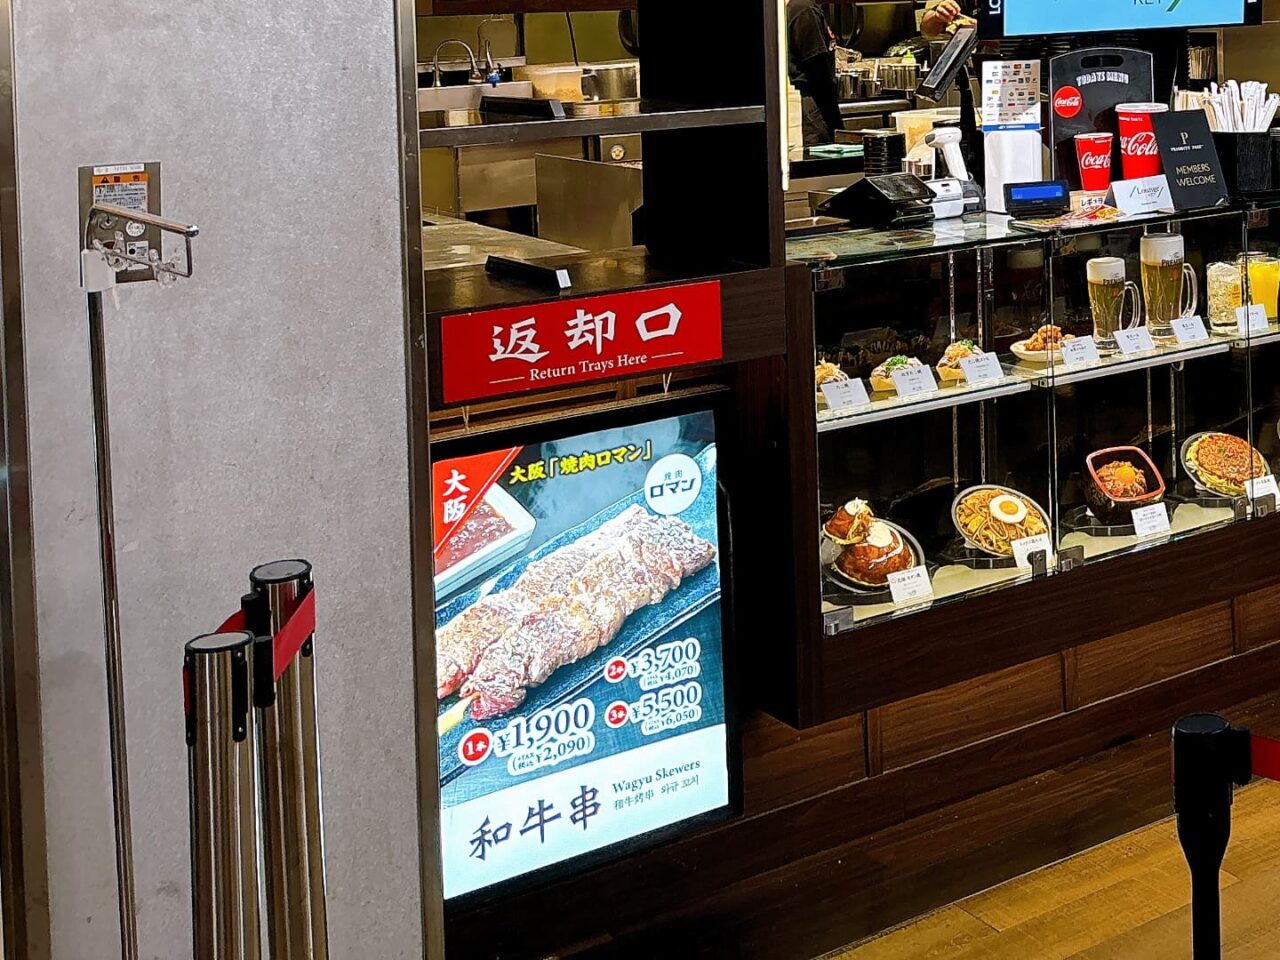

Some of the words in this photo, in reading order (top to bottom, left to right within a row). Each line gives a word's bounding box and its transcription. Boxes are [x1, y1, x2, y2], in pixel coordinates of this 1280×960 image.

[1175, 163, 1211, 175] MEMBERS
[1176, 174, 1217, 187] WELCOME
[488, 302, 683, 364] 返却口
[529, 364, 576, 381] Return
[579, 360, 615, 374] Trays
[617, 352, 648, 366] Here
[508, 439, 653, 485] 大阪「焼肉ロマン」
[442, 469, 471, 525] 大阪
[649, 477, 697, 499] ロマン
[630, 640, 698, 675] ¥3,700
[632, 685, 699, 720] ¥5,500
[497, 702, 591, 754] ¥1,900
[612, 772, 653, 794] Wagyu
[655, 759, 701, 782] Skewers
[468, 784, 603, 861] 和牛串
